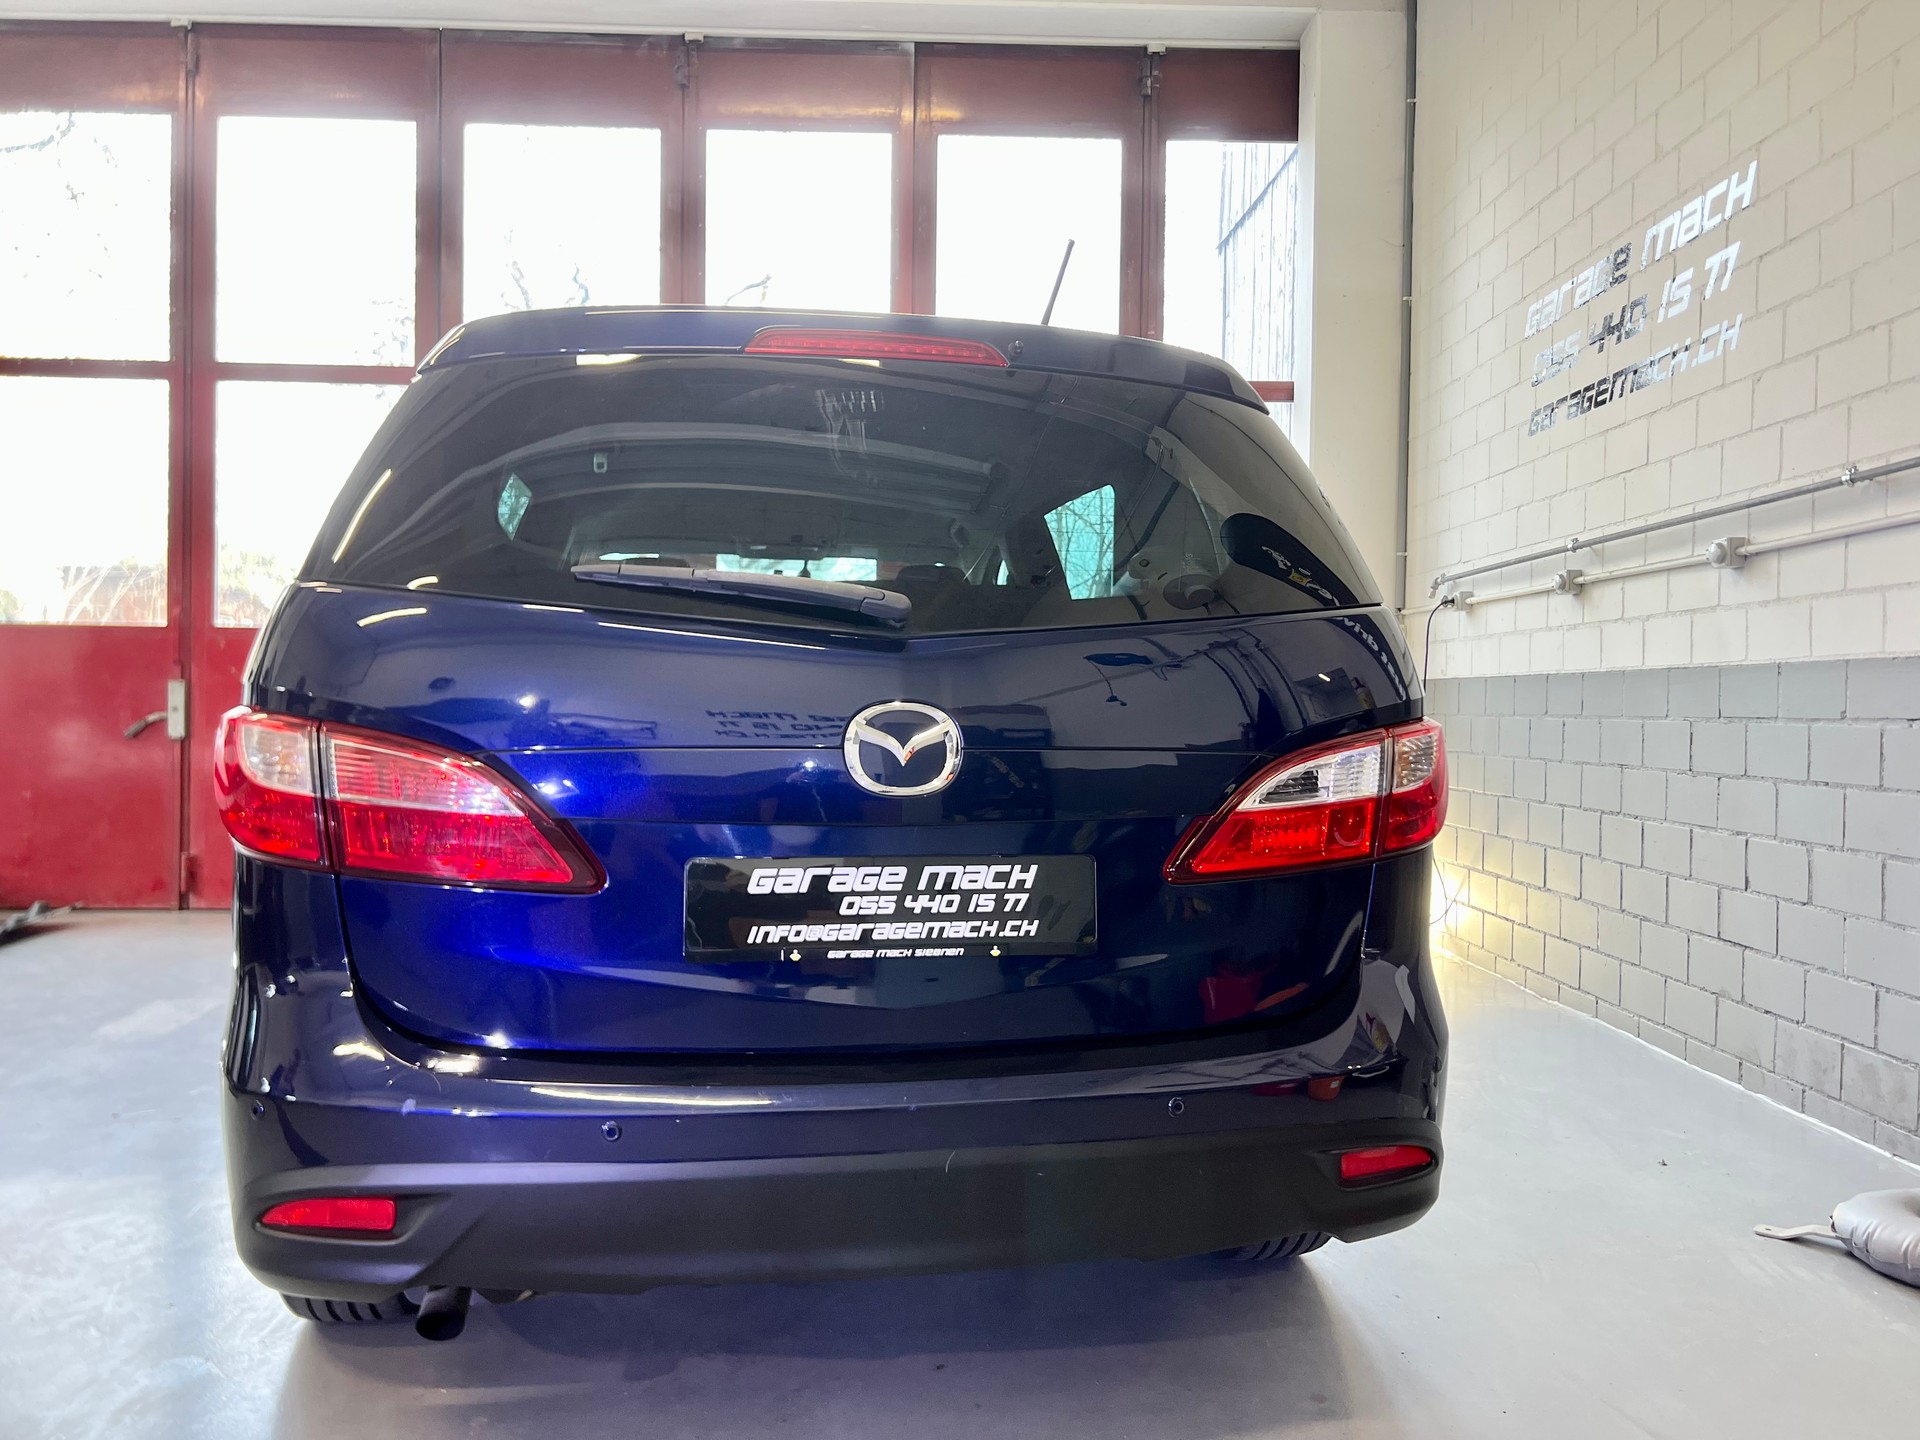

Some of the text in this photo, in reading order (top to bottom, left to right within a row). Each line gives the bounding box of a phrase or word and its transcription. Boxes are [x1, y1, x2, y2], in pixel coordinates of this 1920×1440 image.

[1588, 295, 1648, 354] 440
[1704, 241, 1741, 301] 77
[839, 895, 898, 916] 055
[903, 894, 961, 914] 440
[1002, 893, 1030, 912] 77
